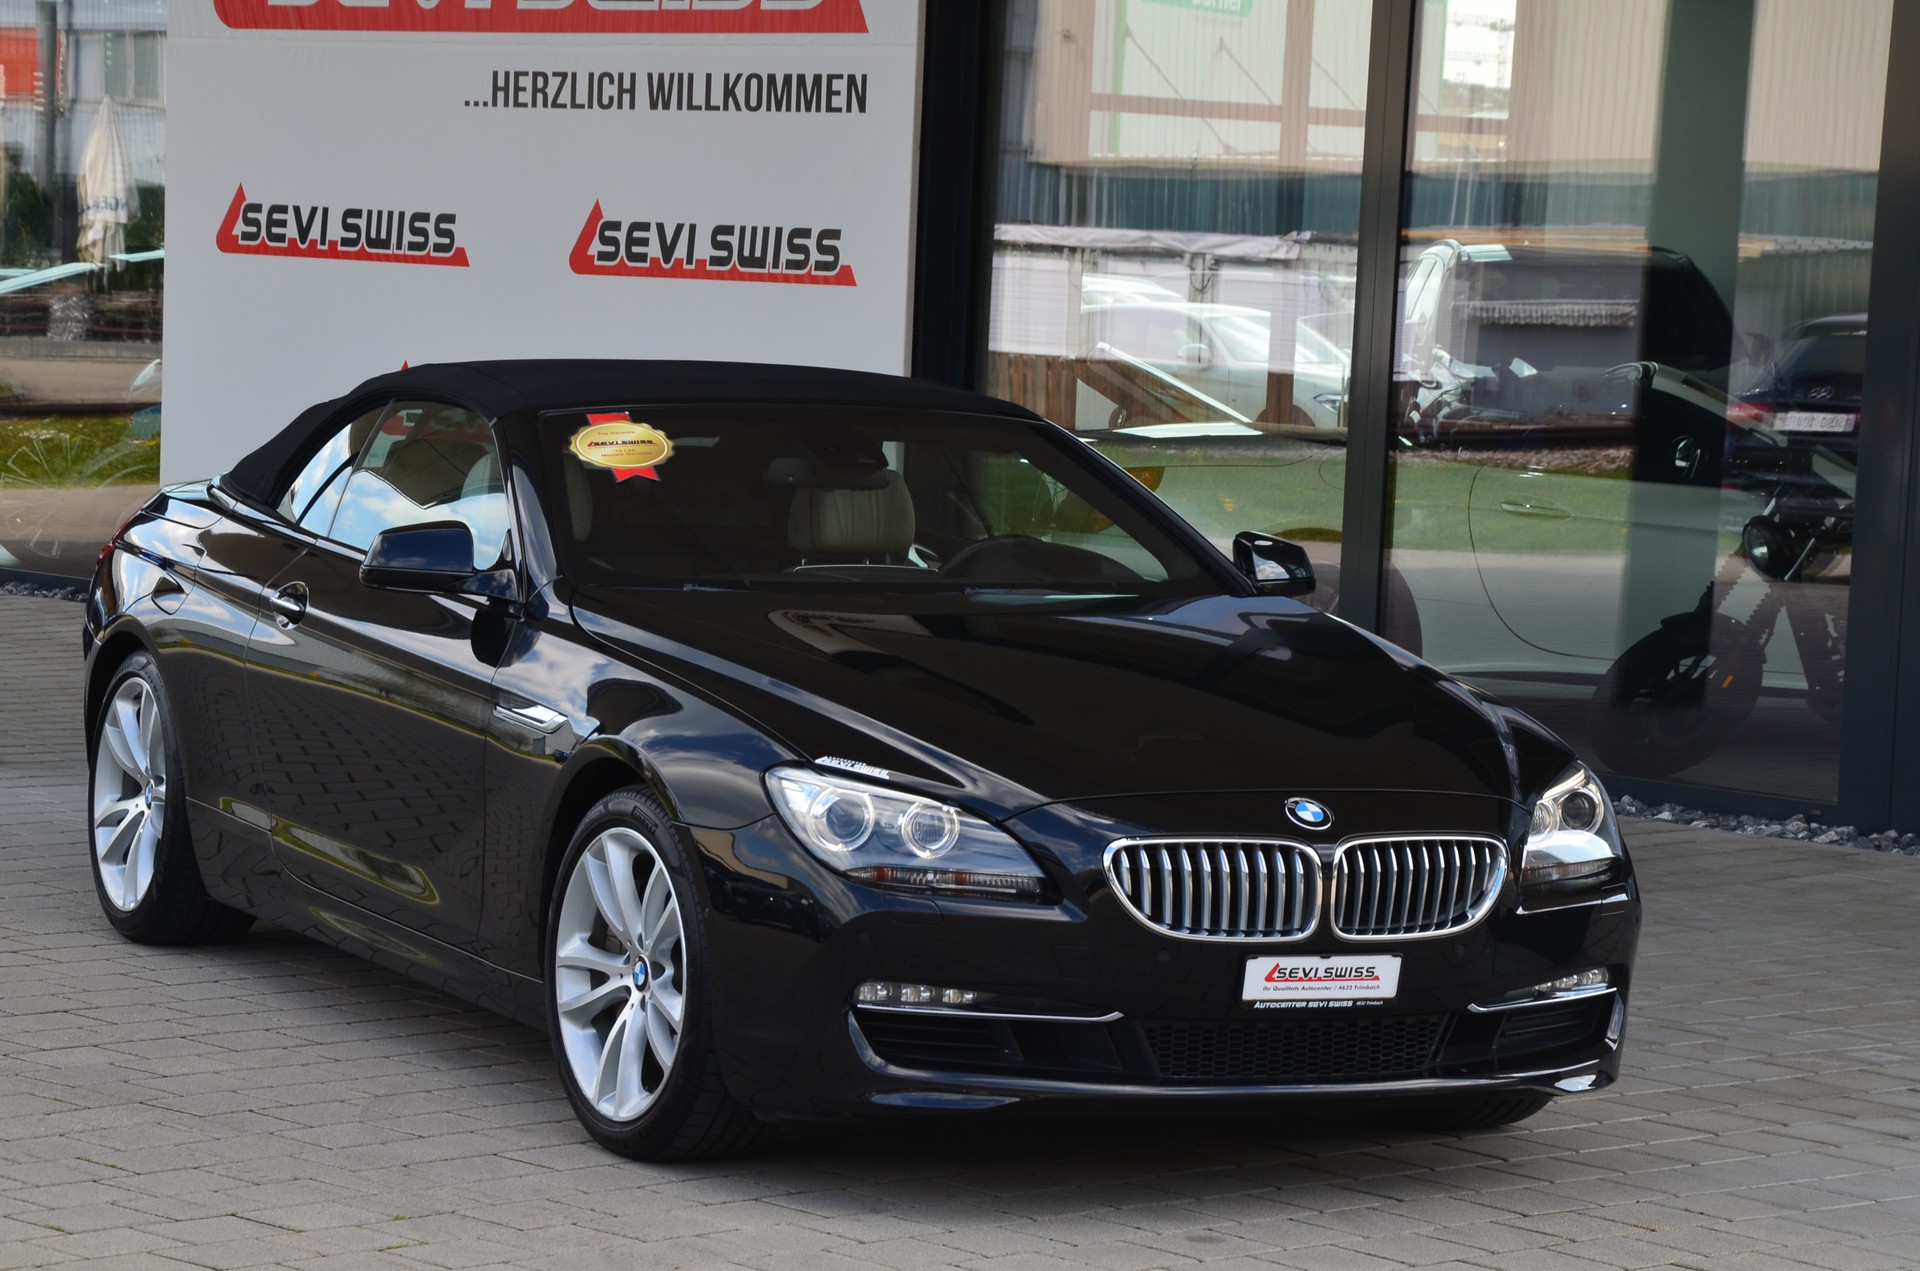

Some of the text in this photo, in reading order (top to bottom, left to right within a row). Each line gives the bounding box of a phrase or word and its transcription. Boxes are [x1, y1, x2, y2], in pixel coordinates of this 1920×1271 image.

[464, 70, 868, 113] ...HERZLICH WILLKOMMEN
[240, 202, 457, 254] SEVI SWISS
[596, 220, 842, 272] SEVI SWISS
[1276, 966, 1376, 979] SEVI SWISS
